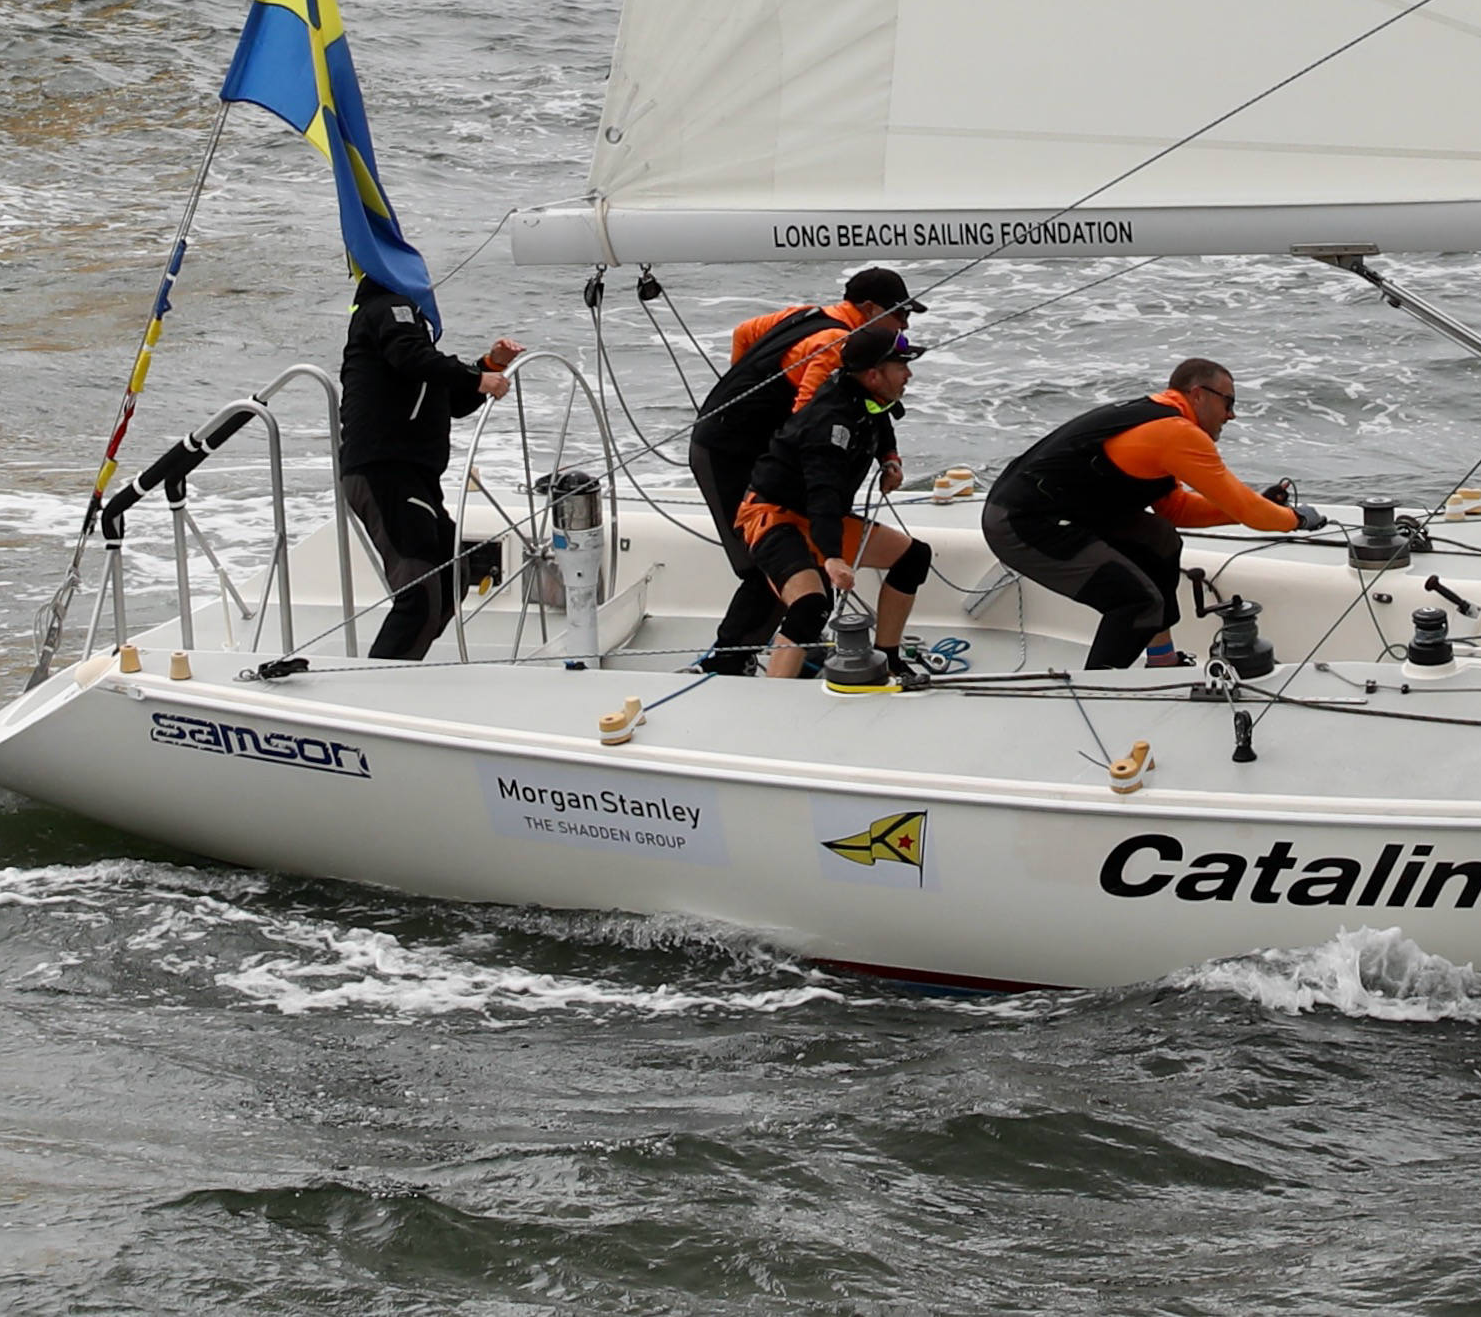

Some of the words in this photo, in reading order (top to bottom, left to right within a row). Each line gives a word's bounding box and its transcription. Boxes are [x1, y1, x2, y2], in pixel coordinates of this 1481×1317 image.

[773, 224, 831, 248] LONG
[837, 223, 907, 247] BEACH
[913, 222, 994, 246] SAILING
[1000, 221, 1134, 246] FOUNDATION
[150, 712, 370, 773] samson
[524, 816, 558, 832] THE
[559, 821, 631, 843] SHADDEN
[635, 831, 686, 849] GROUP
